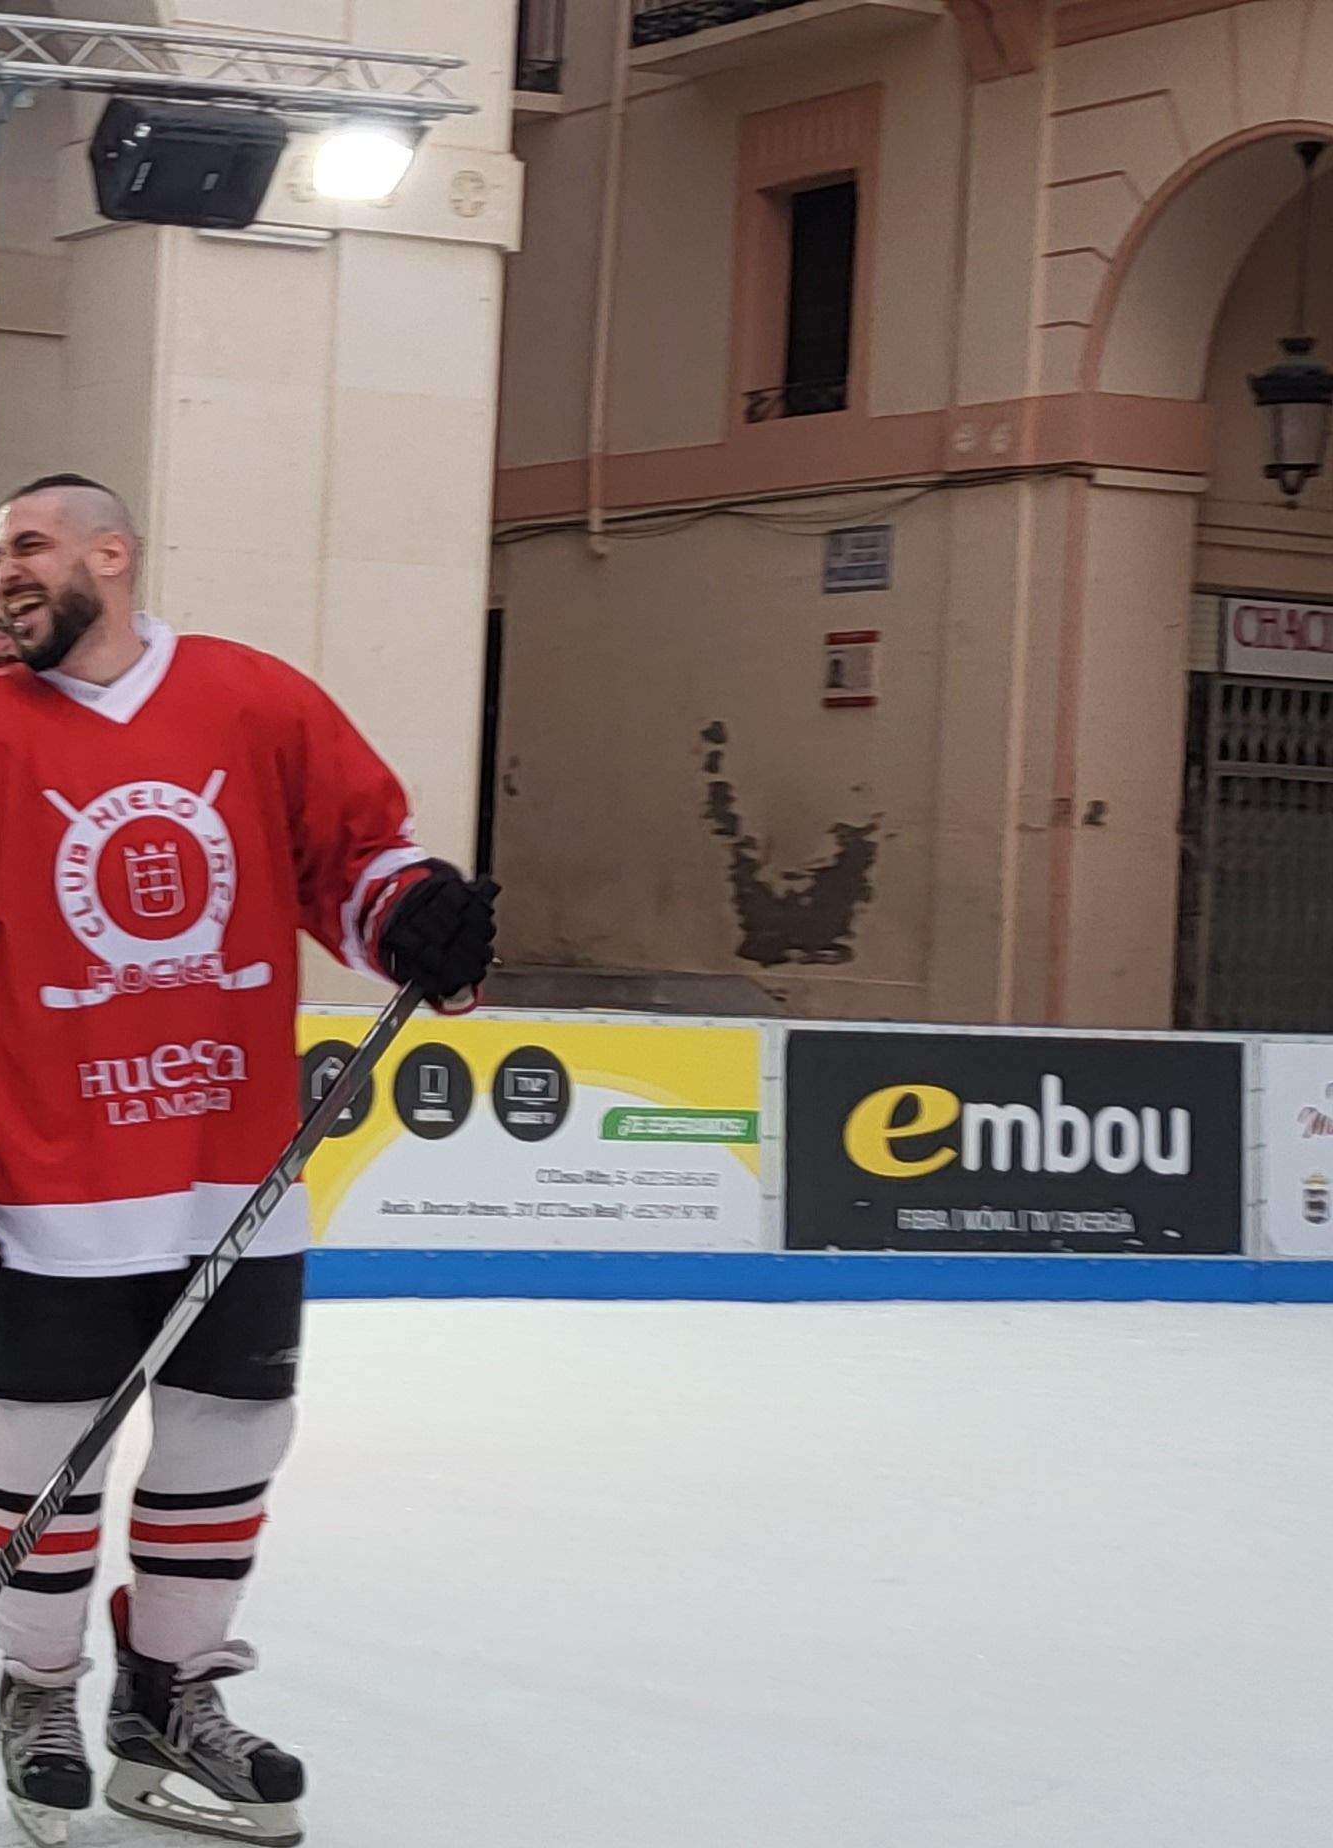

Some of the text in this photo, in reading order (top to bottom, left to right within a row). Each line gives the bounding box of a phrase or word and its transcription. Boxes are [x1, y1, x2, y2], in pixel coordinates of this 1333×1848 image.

[61, 841, 106, 938] CLUB
[86, 786, 200, 831] HIELO
[843, 1073, 1191, 1178] embou
